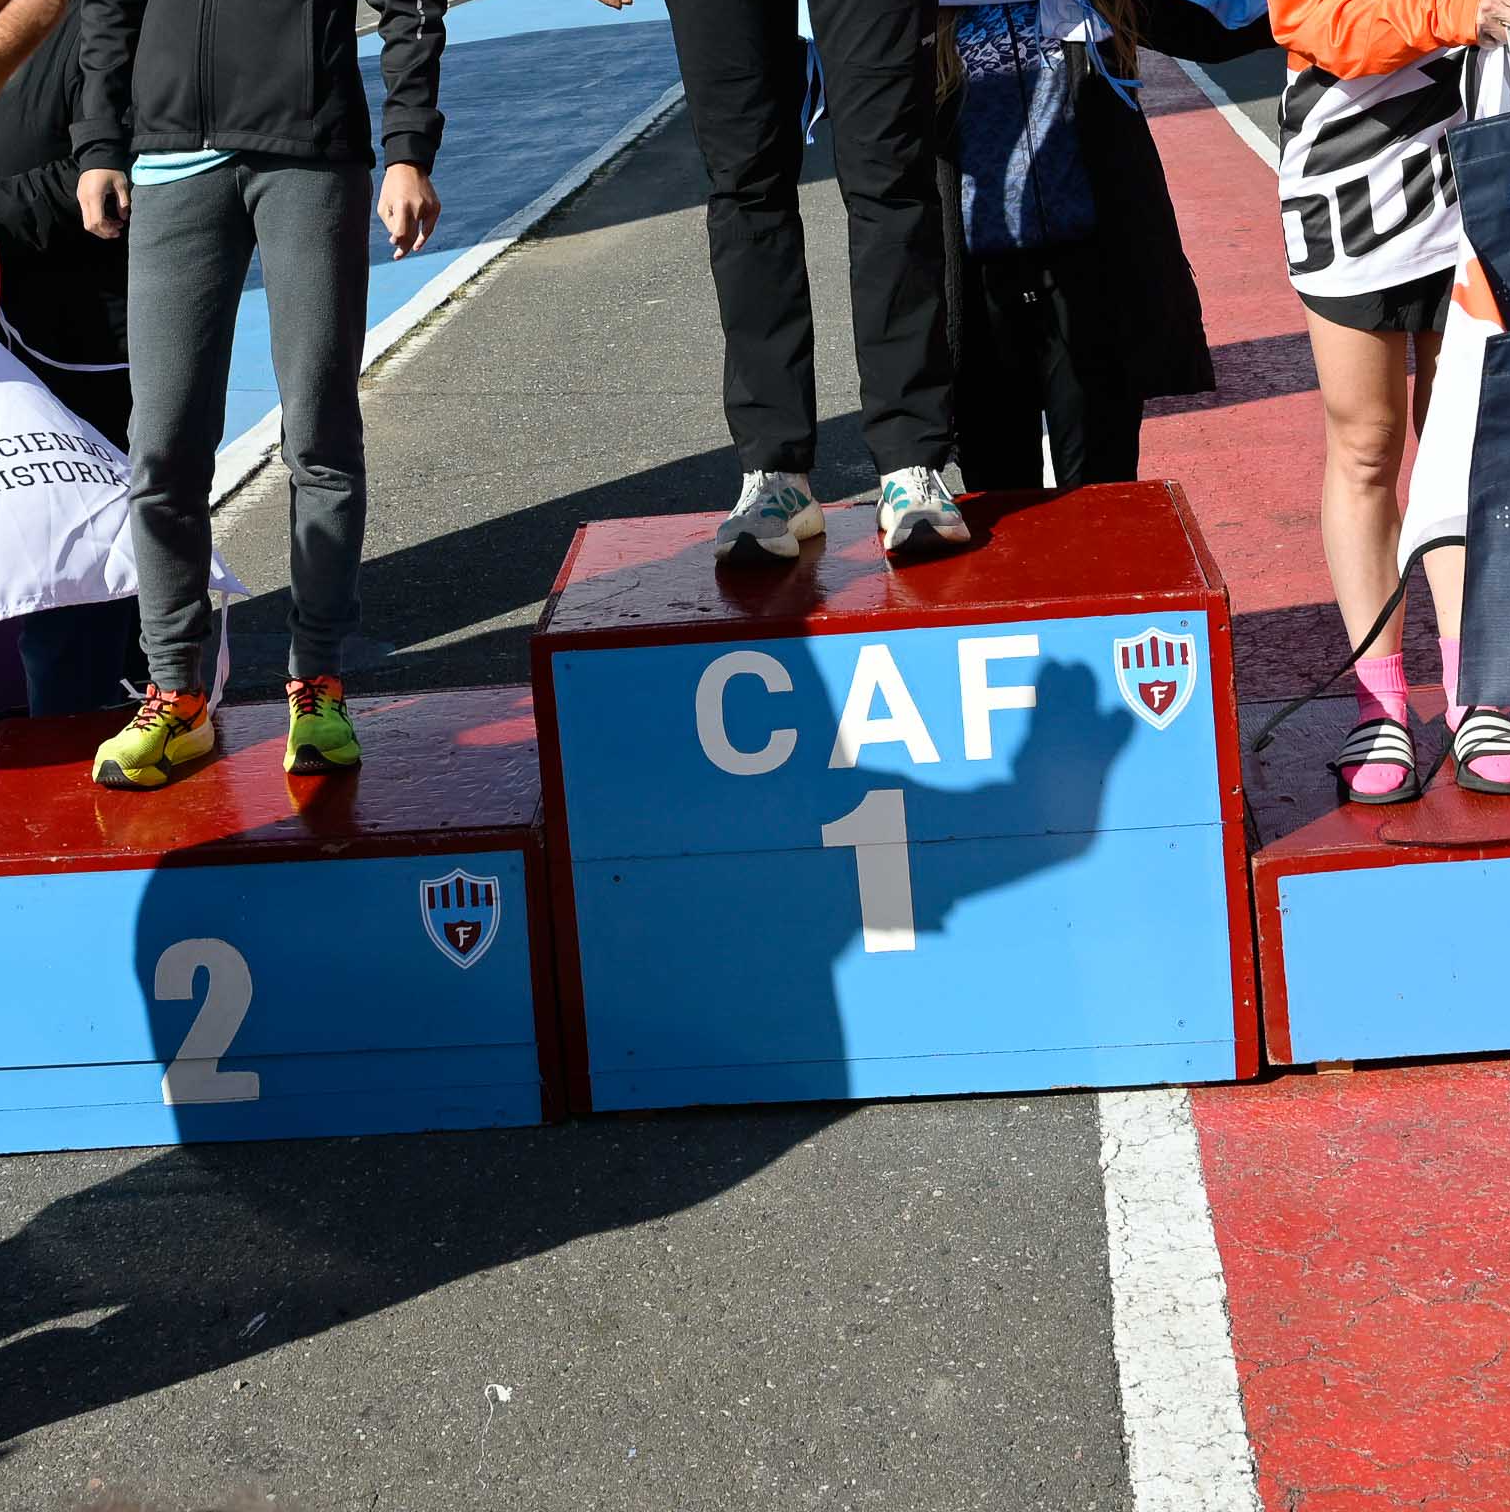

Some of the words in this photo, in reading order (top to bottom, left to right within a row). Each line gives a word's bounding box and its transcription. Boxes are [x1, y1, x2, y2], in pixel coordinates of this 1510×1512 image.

[694, 632, 1040, 777] CAF
[1149, 684, 1170, 709] F
[454, 925, 474, 948] F
[820, 787, 917, 954] 1
[153, 936, 261, 1106] 2
